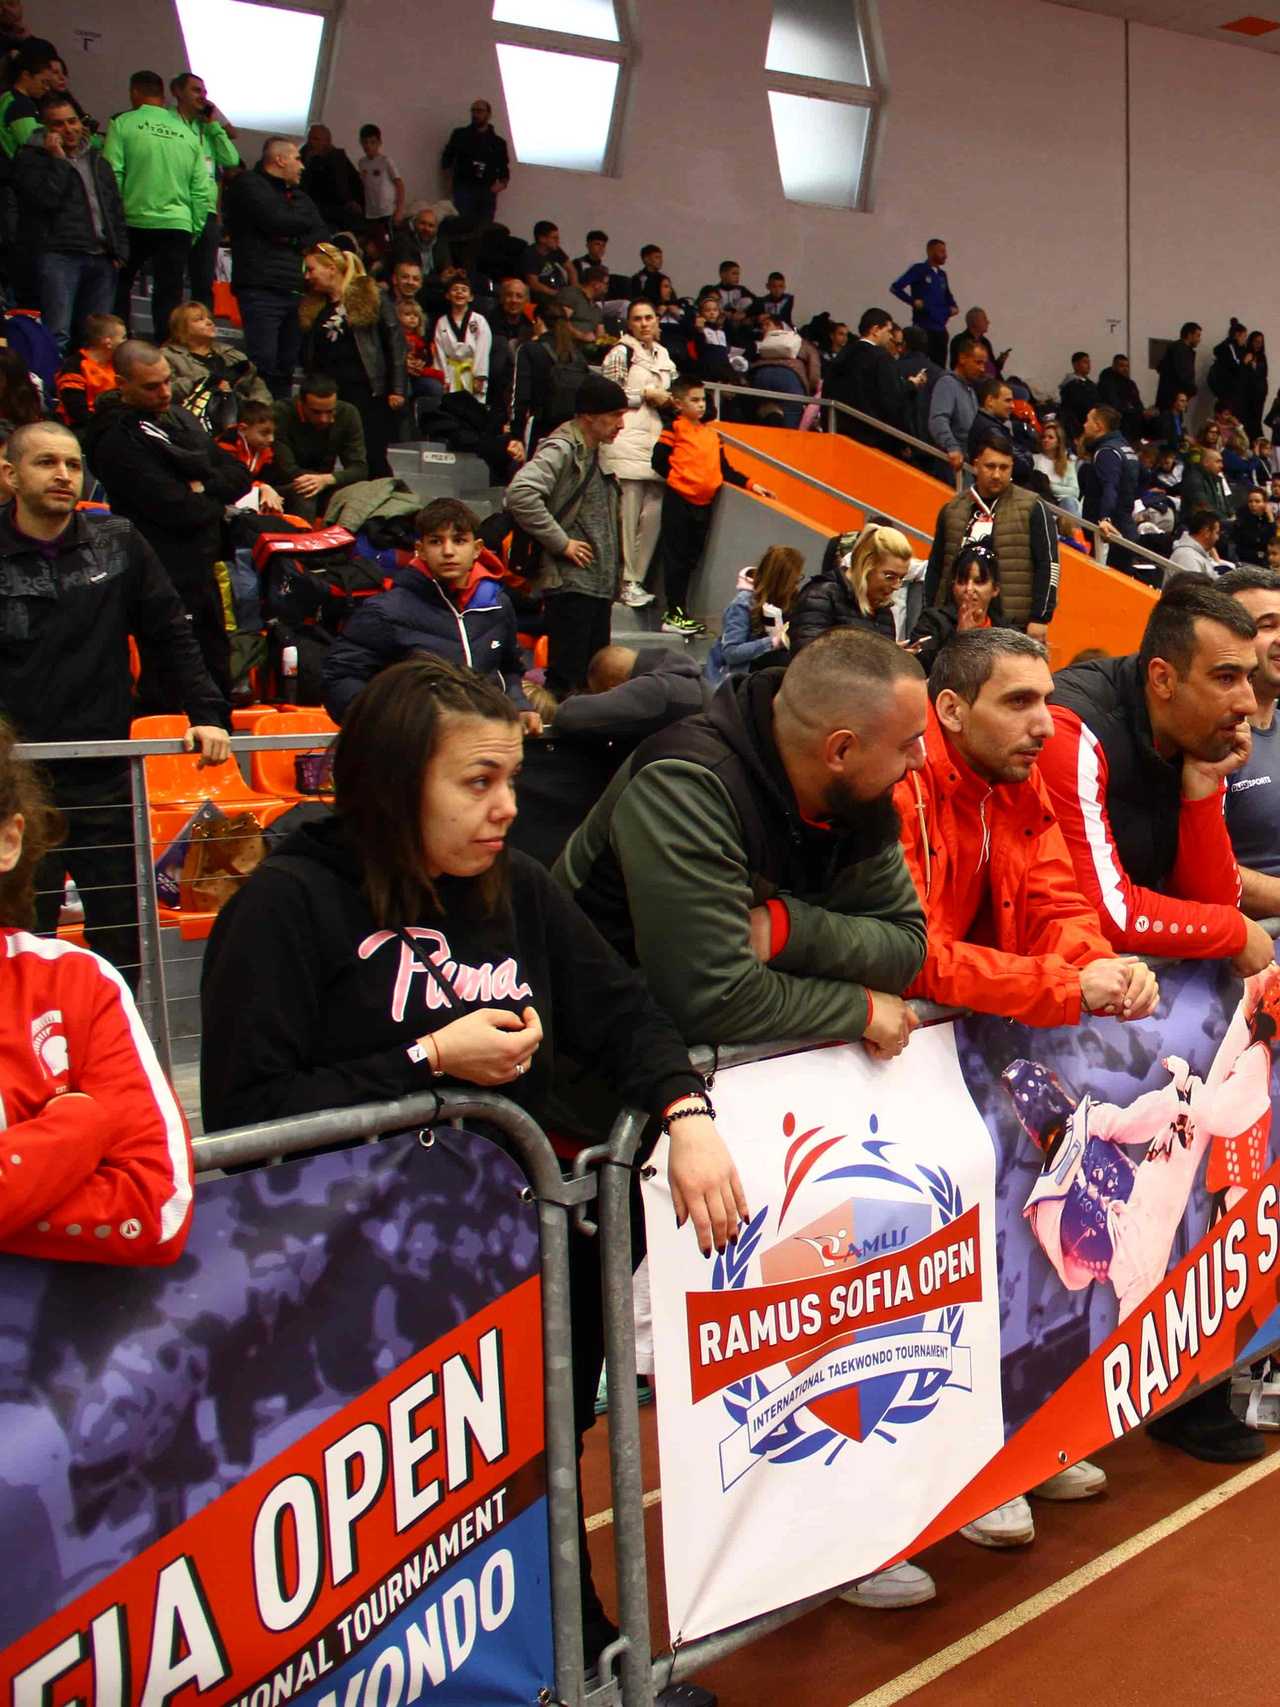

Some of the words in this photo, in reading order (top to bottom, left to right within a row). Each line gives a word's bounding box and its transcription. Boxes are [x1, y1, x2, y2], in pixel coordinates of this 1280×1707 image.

[699, 1293, 822, 1366] RAMUS
[829, 1264, 915, 1327] SOFIA
[919, 1237, 976, 1296] OPEN
[1102, 1217, 1248, 1440] RAMUS
[752, 1371, 826, 1434] INTERNATIONAL
[827, 1351, 894, 1382] TAEKWONDO
[894, 1344, 950, 1362] TOURNAMENT
[252, 1326, 506, 1634] OPEN
[337, 1487, 507, 1656] TOURNAMENT
